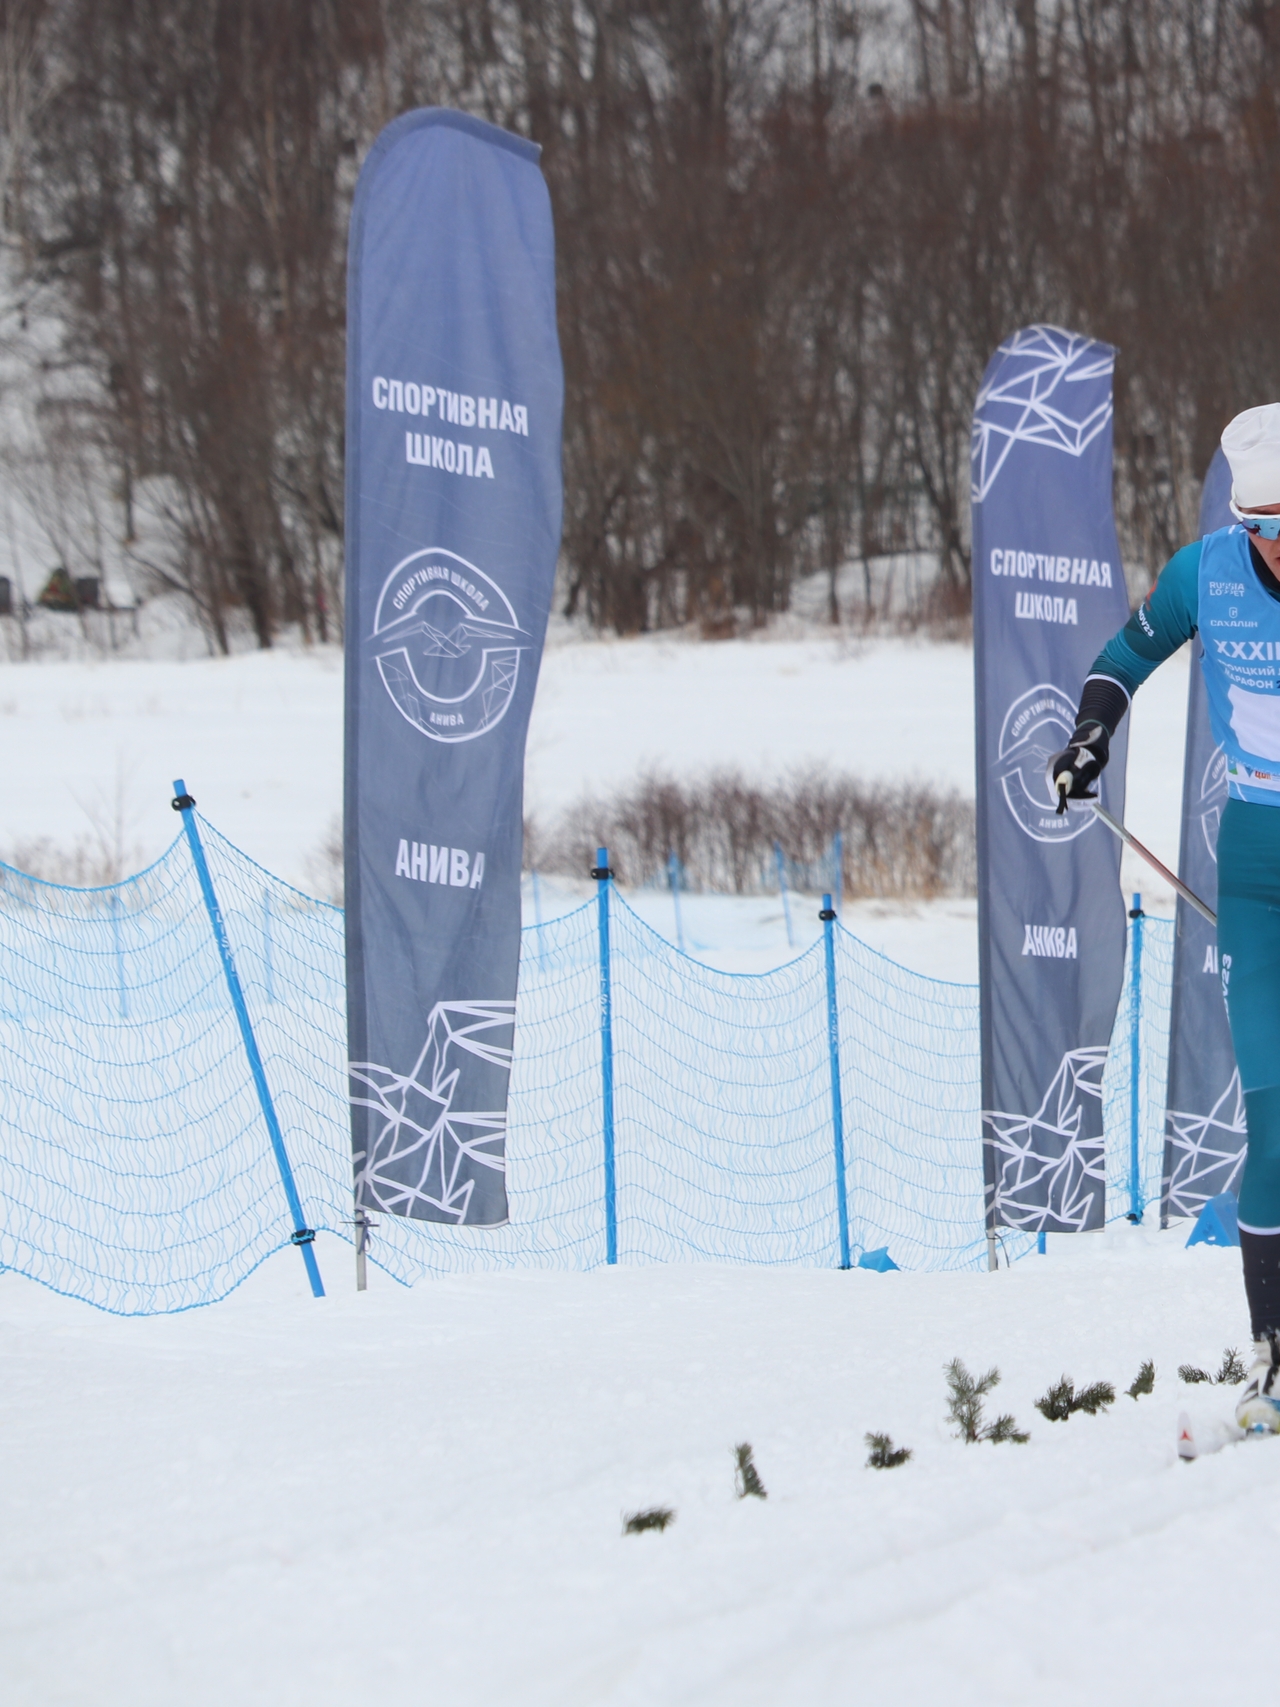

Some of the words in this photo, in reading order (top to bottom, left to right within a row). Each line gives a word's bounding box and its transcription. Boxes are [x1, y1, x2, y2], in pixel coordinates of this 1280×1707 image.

[372, 375, 529, 437] СПОРТИВНАЯ
[405, 430, 495, 479] ШКОЛА
[990, 547, 1112, 588] СПОРТИВНАЯ
[393, 565, 450, 610] СПОРТИВНАЯ
[450, 570, 490, 612] ШКОЛА
[1015, 591, 1078, 625] ШКОЛА
[1210, 619, 1258, 628] САХАЛИН
[1218, 659, 1275, 676] ОИЦКИЙ
[429, 712, 464, 727] АНИВА
[1038, 817, 1069, 829] АНИВА
[395, 838, 485, 889] АНИВА
[1021, 924, 1077, 959] АНИВА
